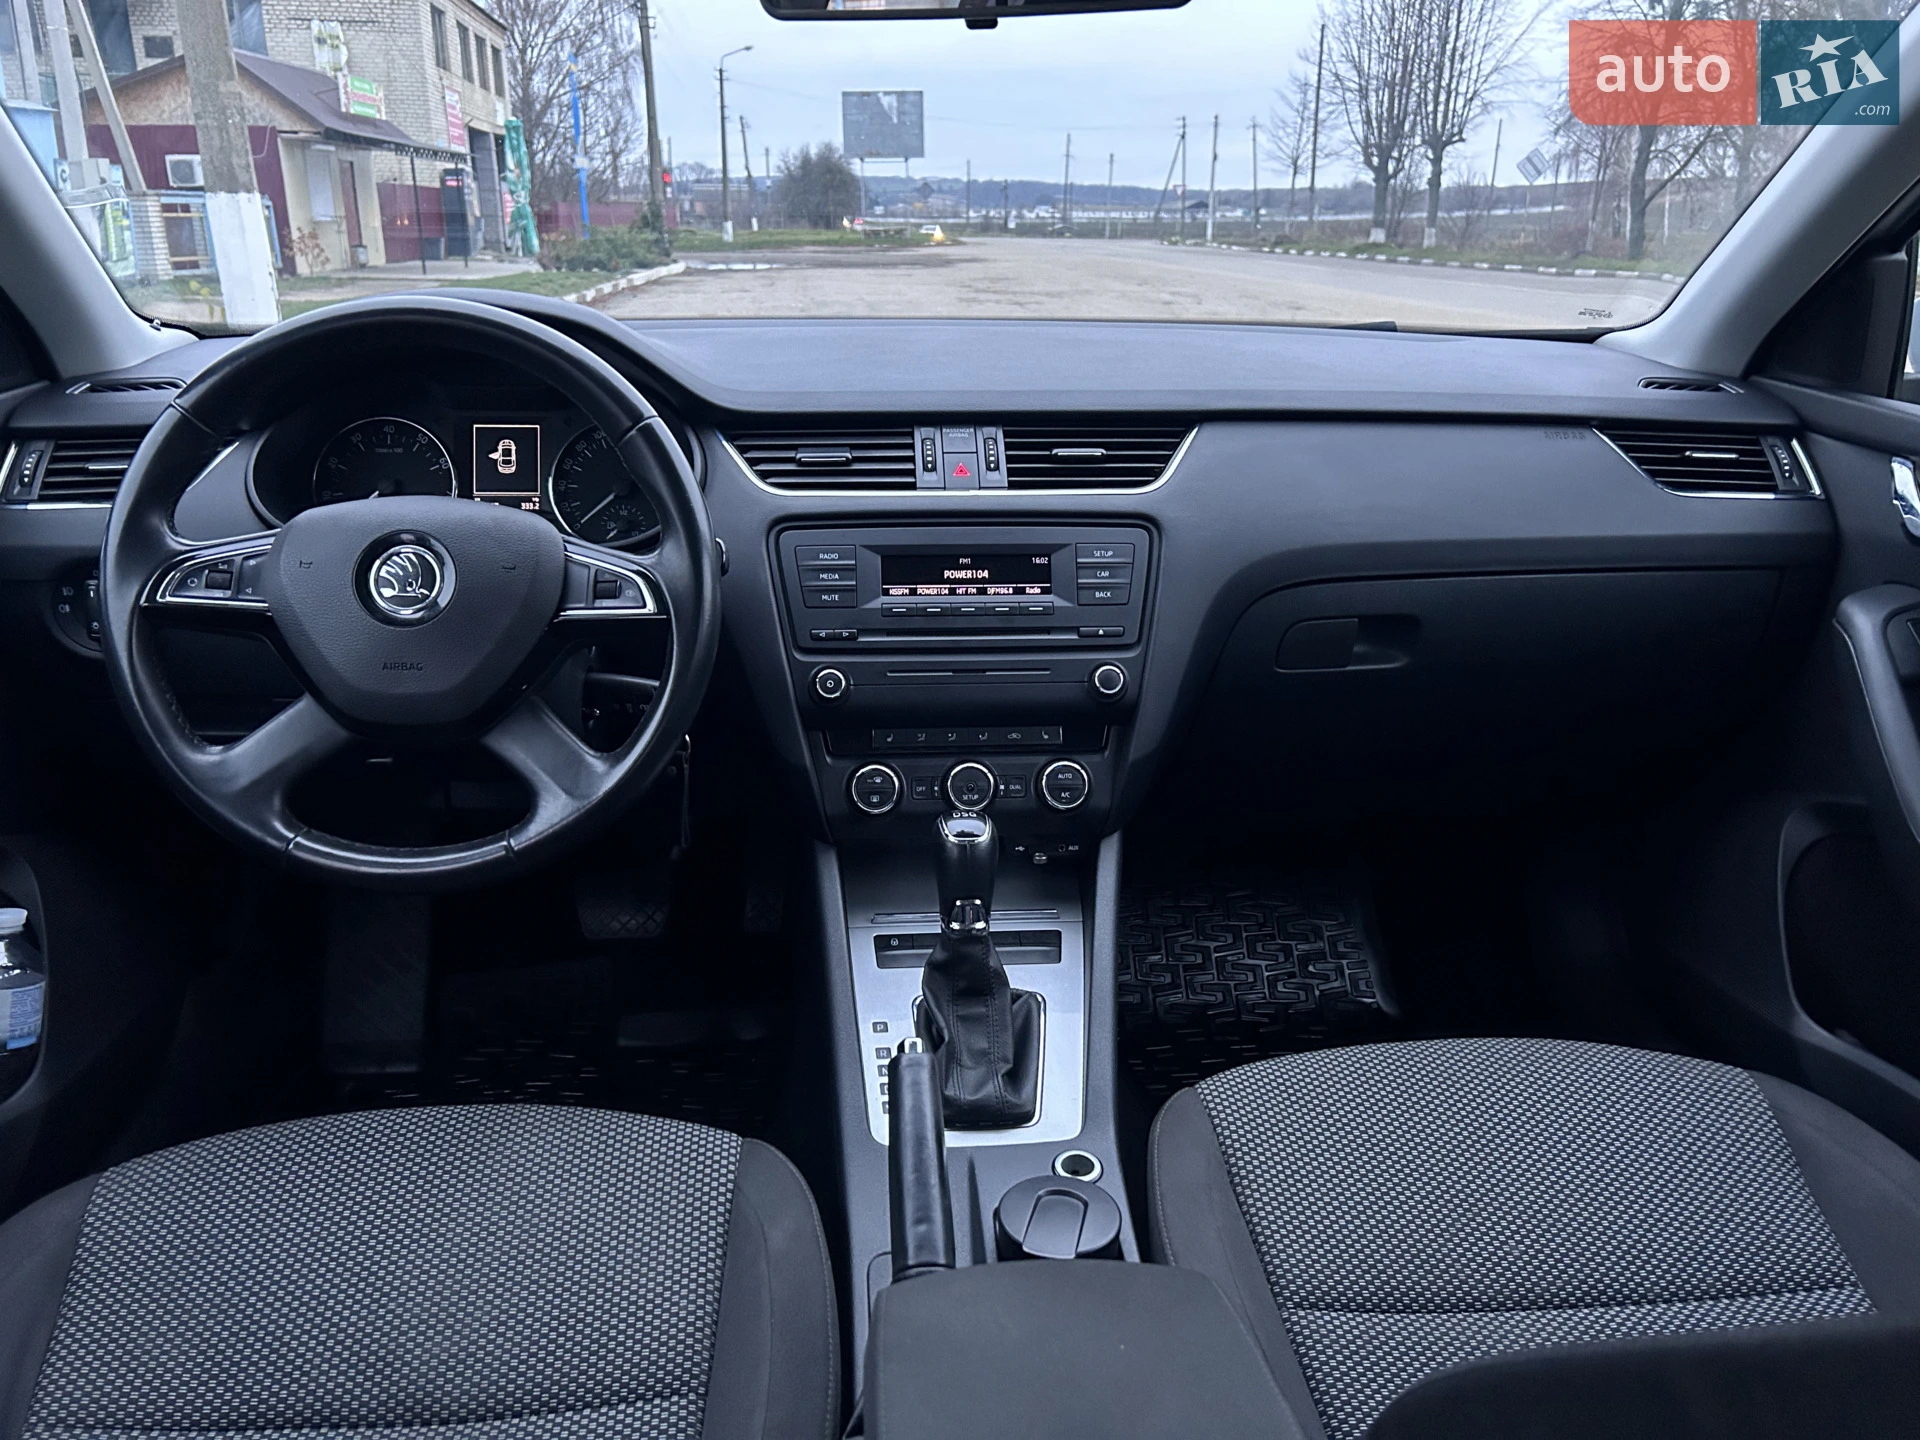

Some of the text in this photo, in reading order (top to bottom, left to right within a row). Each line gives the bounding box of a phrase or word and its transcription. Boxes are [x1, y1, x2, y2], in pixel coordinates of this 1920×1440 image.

[383, 425, 395, 433] 40
[416, 433, 429, 444] 50
[1543, 431, 1586, 440] AIRBAG
[575, 440, 587, 452] 80
[439, 457, 450, 470] 60
[562, 459, 573, 470] 60
[558, 480, 566, 491] 40
[521, 502, 540, 510] 333.2
[561, 502, 571, 512] 20
[819, 552, 839, 560] RADIO
[943, 569, 989, 579] POWER104
[916, 587, 949, 595] POWER104
[956, 587, 977, 595] HIT FM
[1025, 586, 1041, 594] Radio
[382, 662, 423, 671] AIRBAG
[876, 1024, 884, 1032] P
